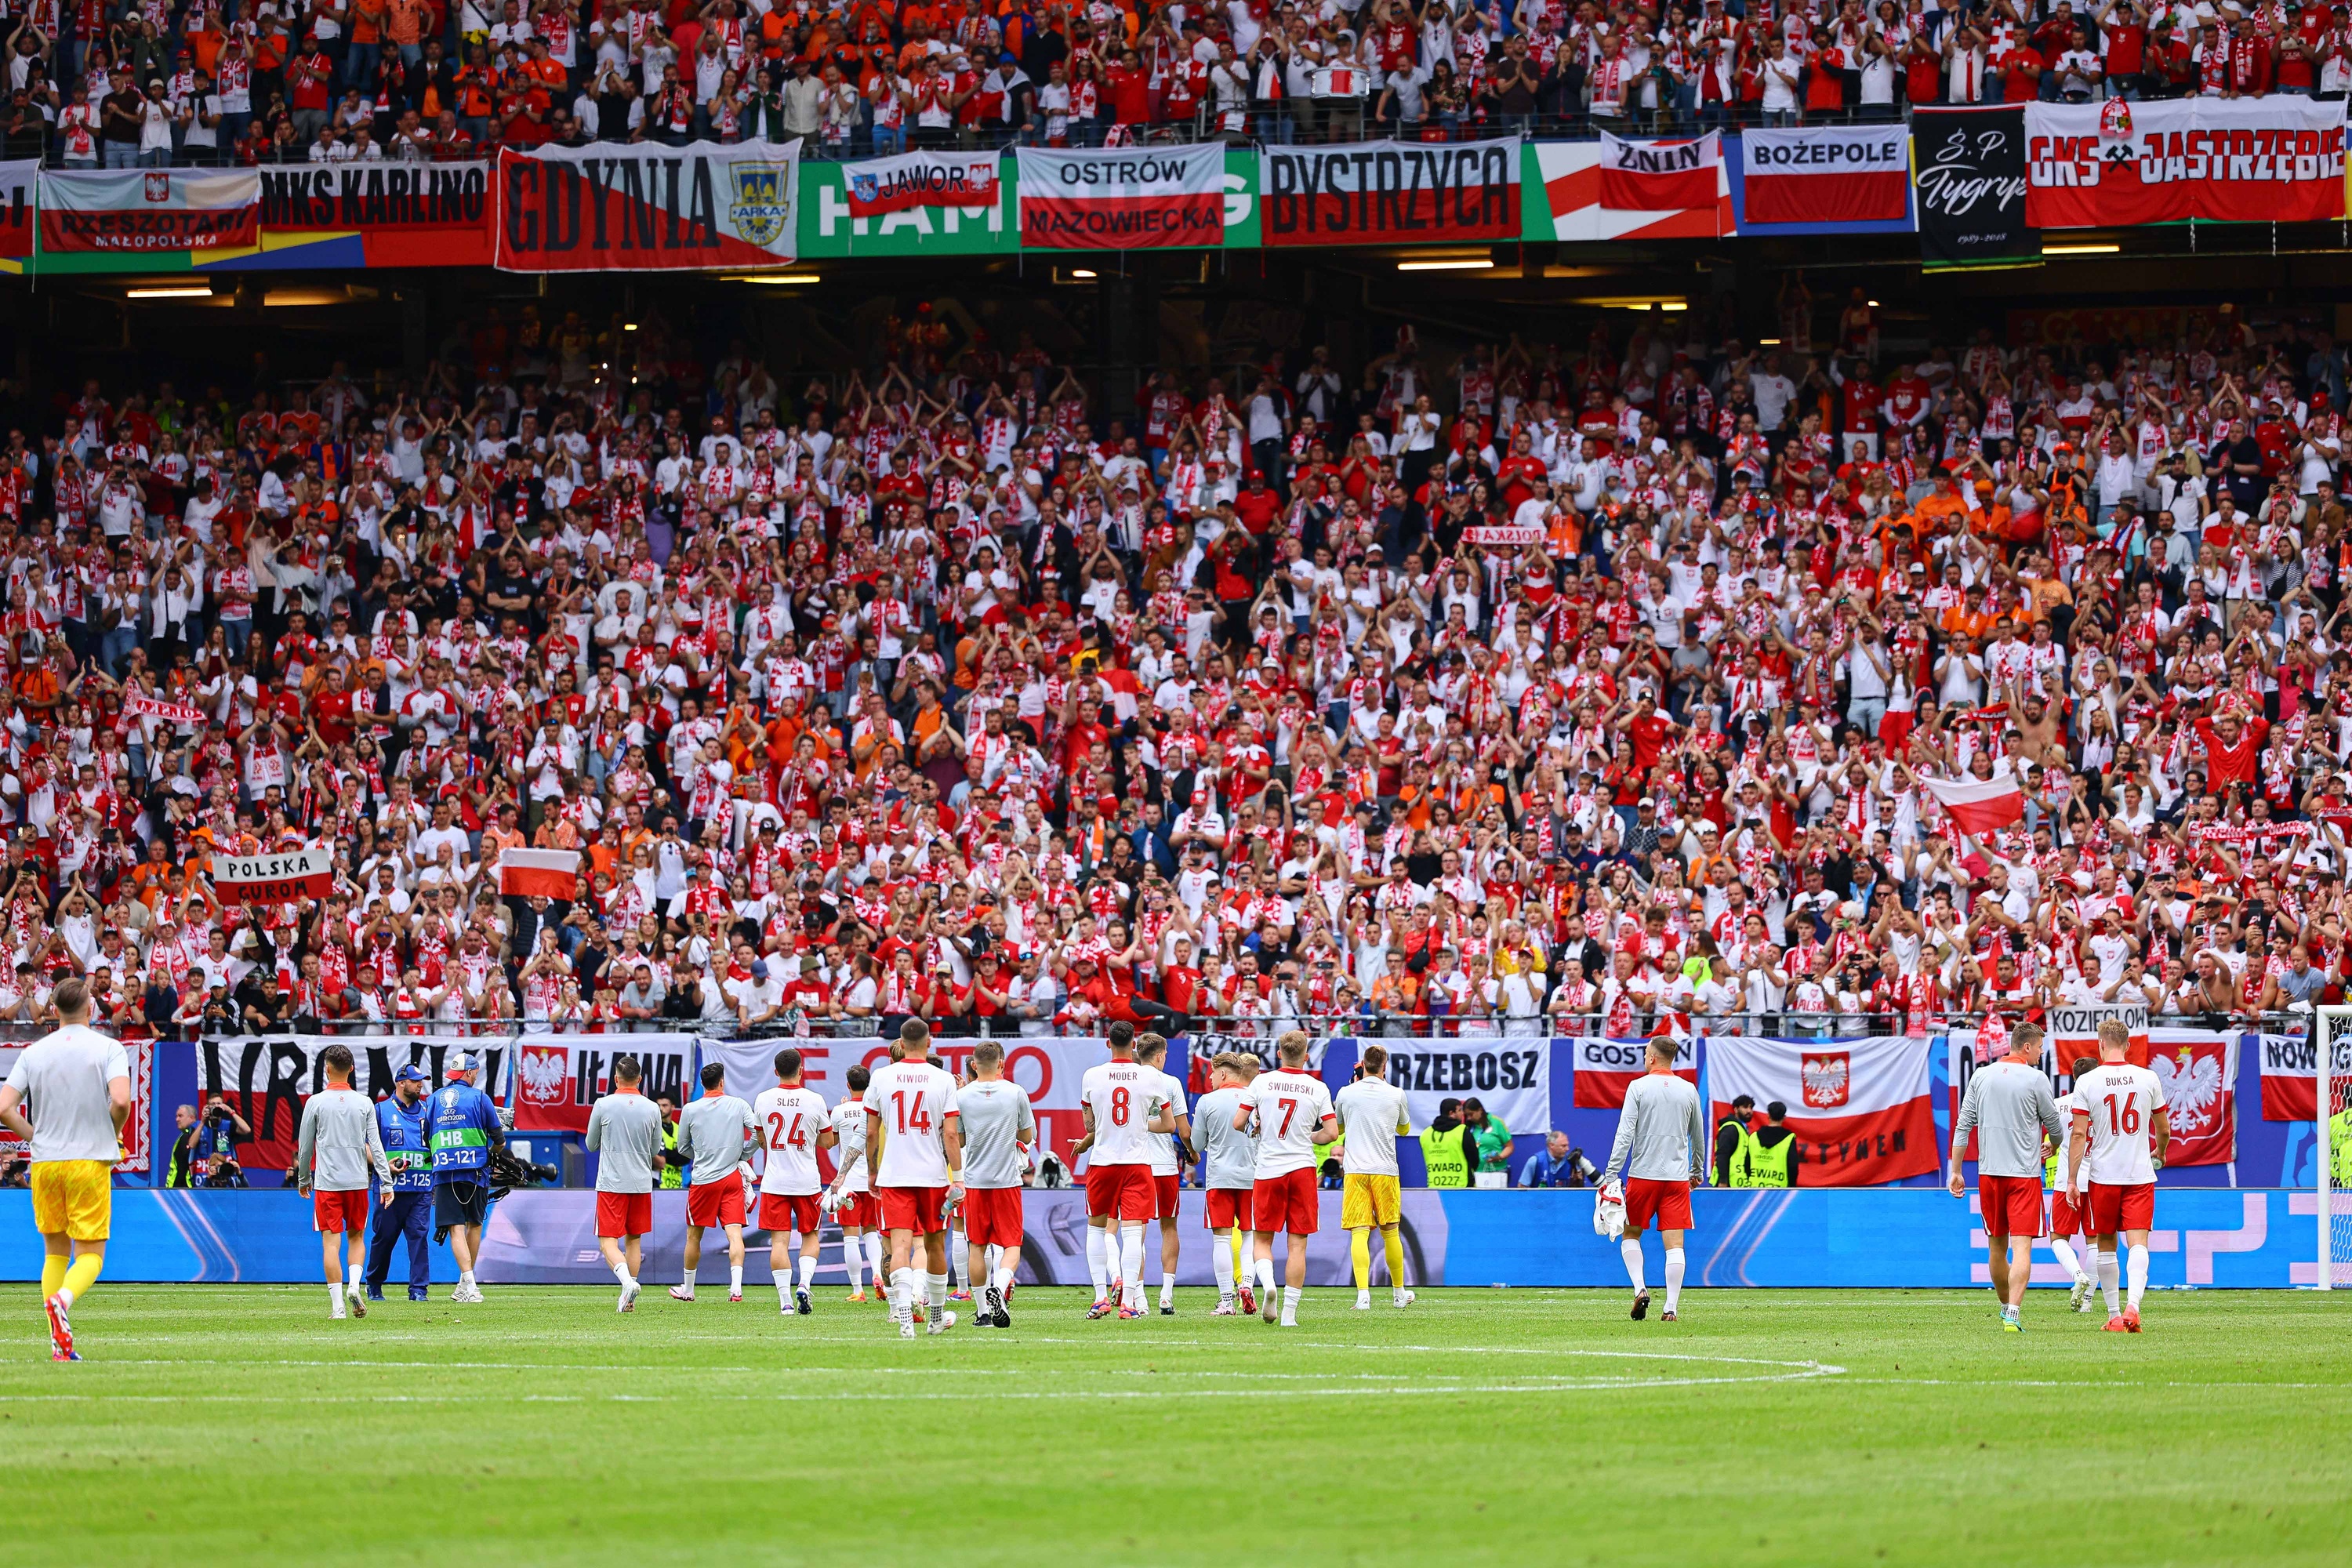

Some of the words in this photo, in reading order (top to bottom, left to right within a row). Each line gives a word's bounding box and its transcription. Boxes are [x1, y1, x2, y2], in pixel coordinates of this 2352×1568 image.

[1617, 141, 1704, 173] ŻNIN
[1755, 137, 1897, 165] BOŻEPOLE
[2030, 136, 2100, 187] GKS
[2140, 125, 2345, 185] JASTRZĘBIE
[881, 165, 967, 199] JAWOR
[1061, 155, 1187, 185] OSTRÓW
[261, 169, 332, 226] MKS
[342, 166, 484, 225] KARLINO
[1271, 147, 1508, 234] BYSTRZYCA
[508, 158, 720, 252] GDYNIA
[739, 206, 782, 218] ARKA
[61, 209, 249, 234] RZESZOTARY
[1028, 207, 1220, 234] MAZOWIECKA
[95, 234, 217, 248] MAŁOPOLSKA
[227, 856, 310, 877] POLSKA
[238, 880, 308, 900] GUROM
[1585, 1039, 1691, 1065] GOSTŃ
[896, 1073, 929, 1083] KIWIOR
[1109, 1071, 1138, 1081] MODER
[1386, 1051, 1538, 1091] RZEBOSZ
[2106, 1076, 2134, 1087] BUKSA
[1268, 1081, 1314, 1096] ŚWIDERSKI
[777, 1098, 800, 1107] SLISZ
[891, 1090, 932, 1135] 14
[1111, 1087, 1131, 1129] 8
[2103, 1092, 2140, 1136] 16
[768, 1112, 807, 1151] 24
[1278, 1098, 1298, 1140] 7
[440, 1131, 463, 1146] HB
[402, 1152, 424, 1168] HB
